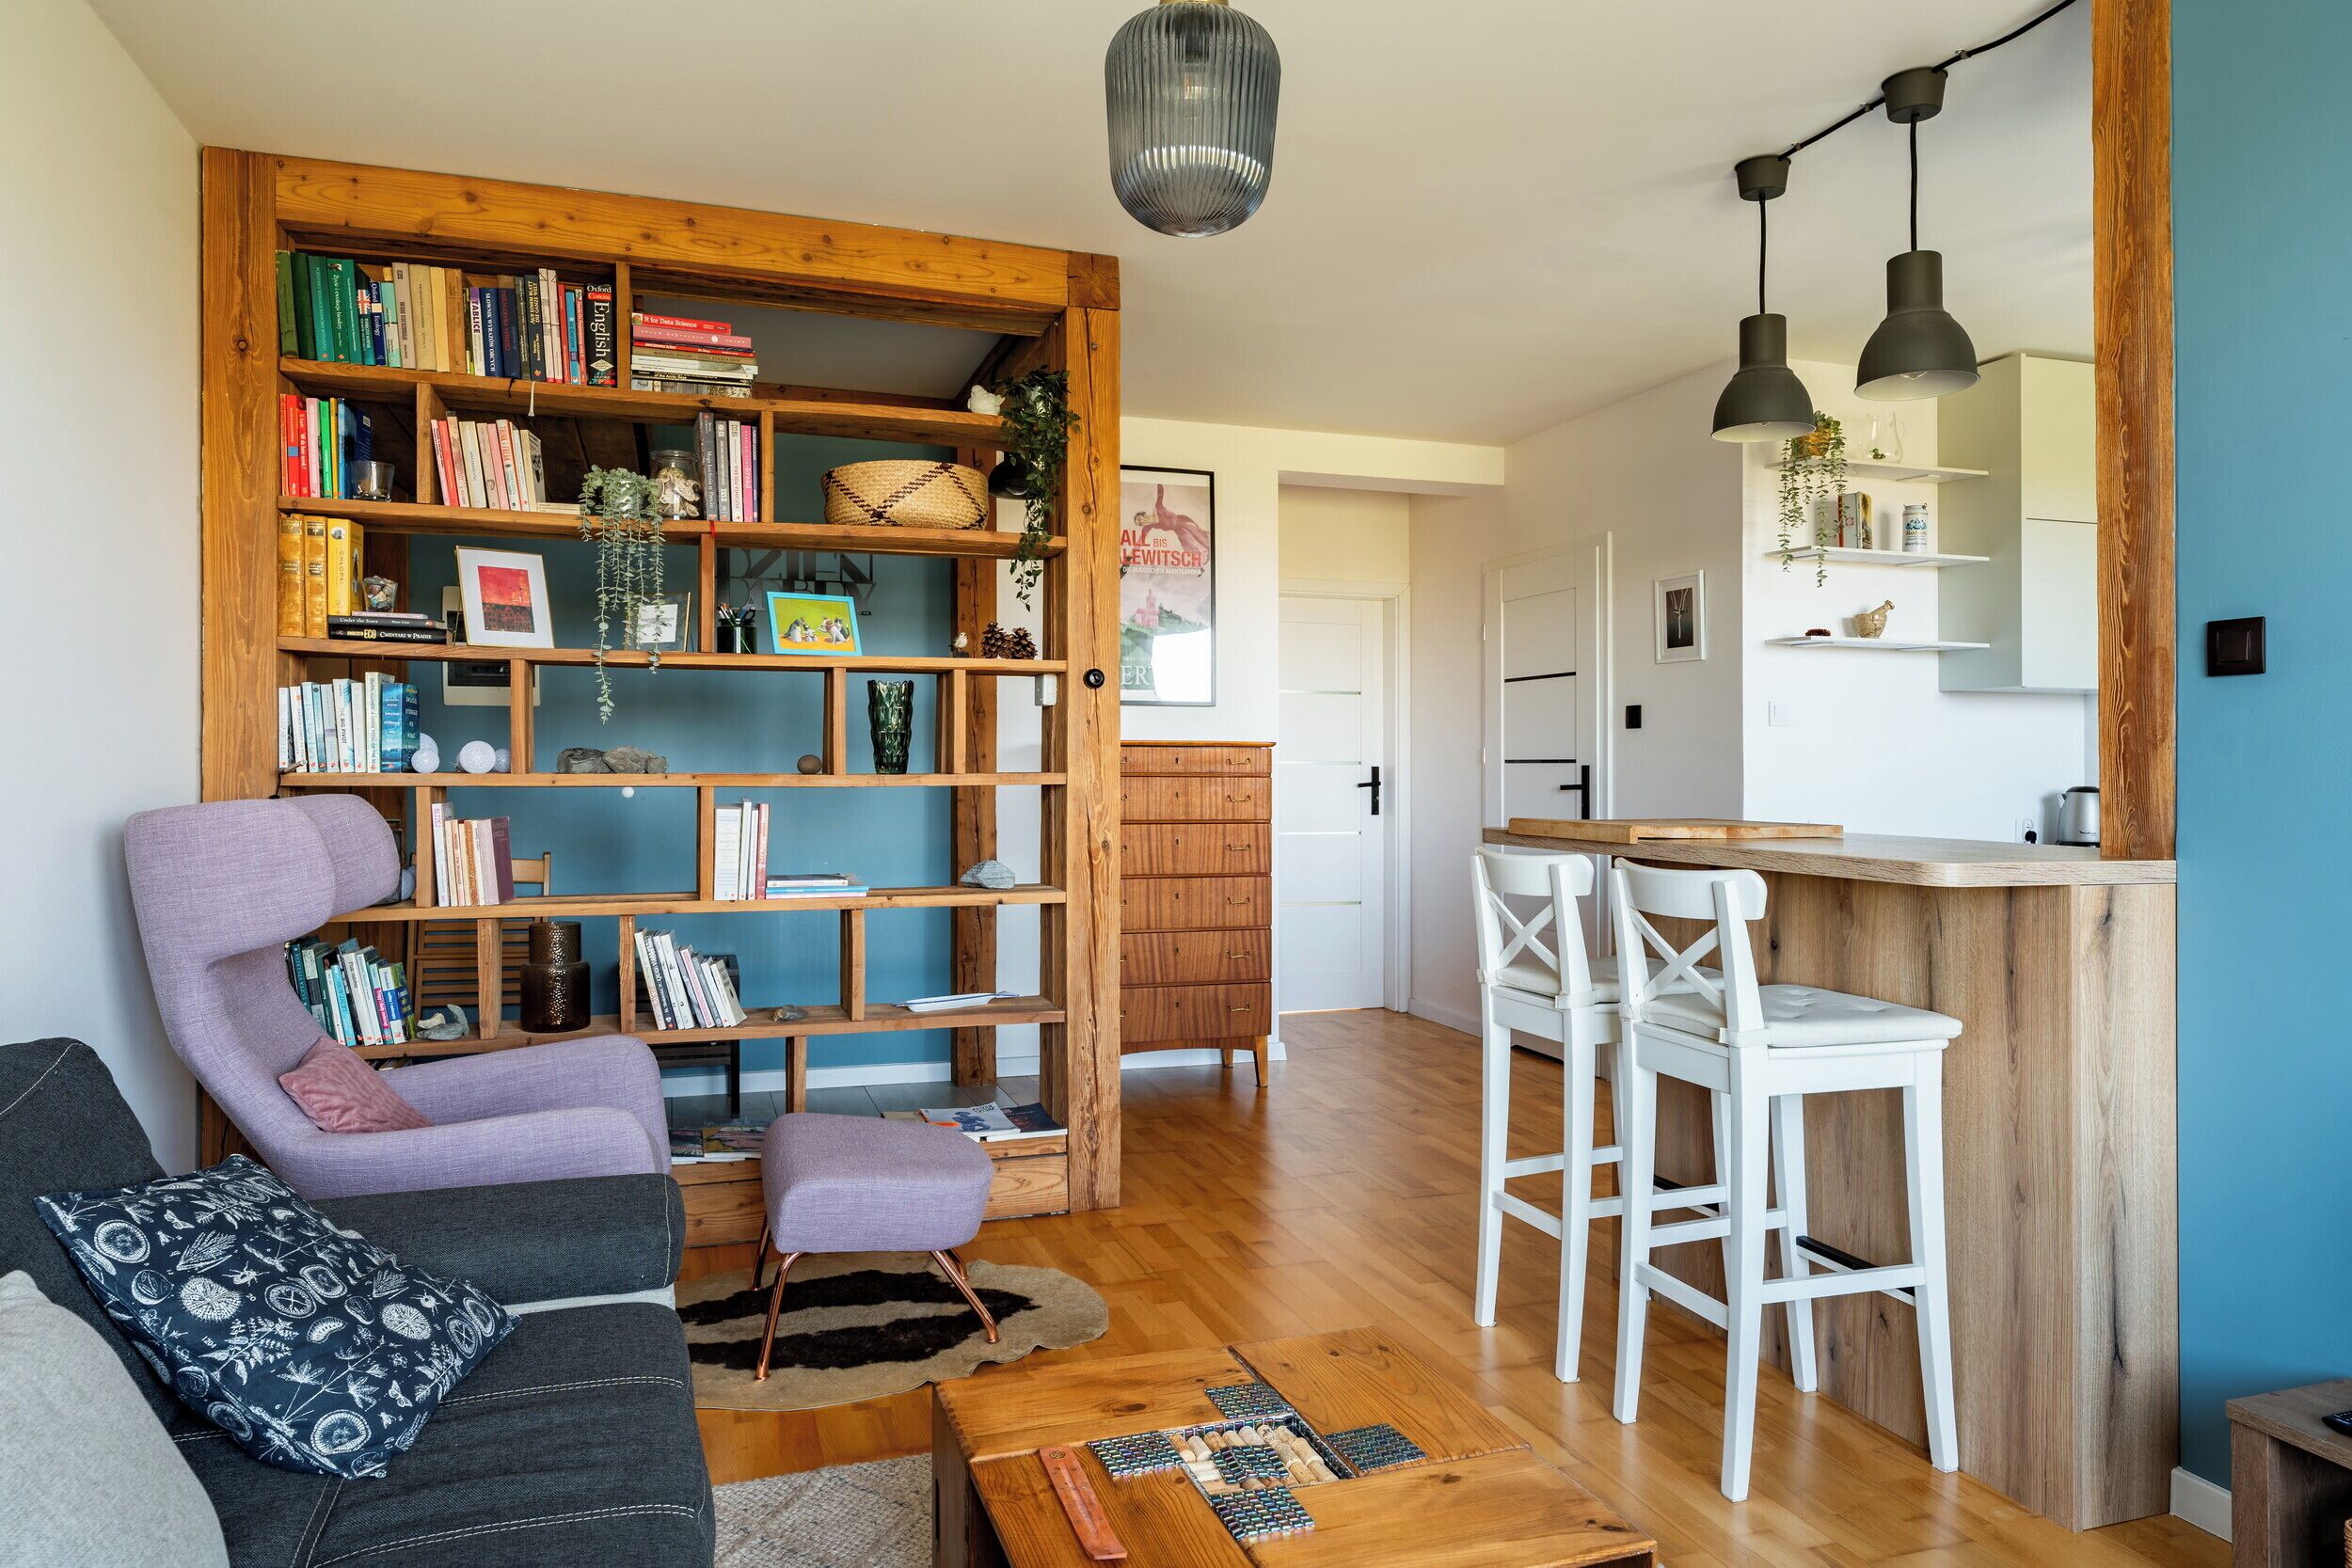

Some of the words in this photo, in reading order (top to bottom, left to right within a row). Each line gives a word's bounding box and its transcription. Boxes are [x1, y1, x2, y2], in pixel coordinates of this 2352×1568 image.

[587, 285, 612, 293] Oxford
[471, 300, 481, 334] TABLICE
[675, 319, 698, 328] Science
[590, 301, 612, 357] English
[1120, 530, 1151, 546] ALL
[1153, 537, 1168, 547] BIS
[1122, 548, 1201, 567] LEWITSCH
[363, 628, 377, 640] ECO
[379, 630, 406, 639] CMENTARZ
[412, 632, 433, 641] PRADZE
[1120, 665, 1151, 686] ER
